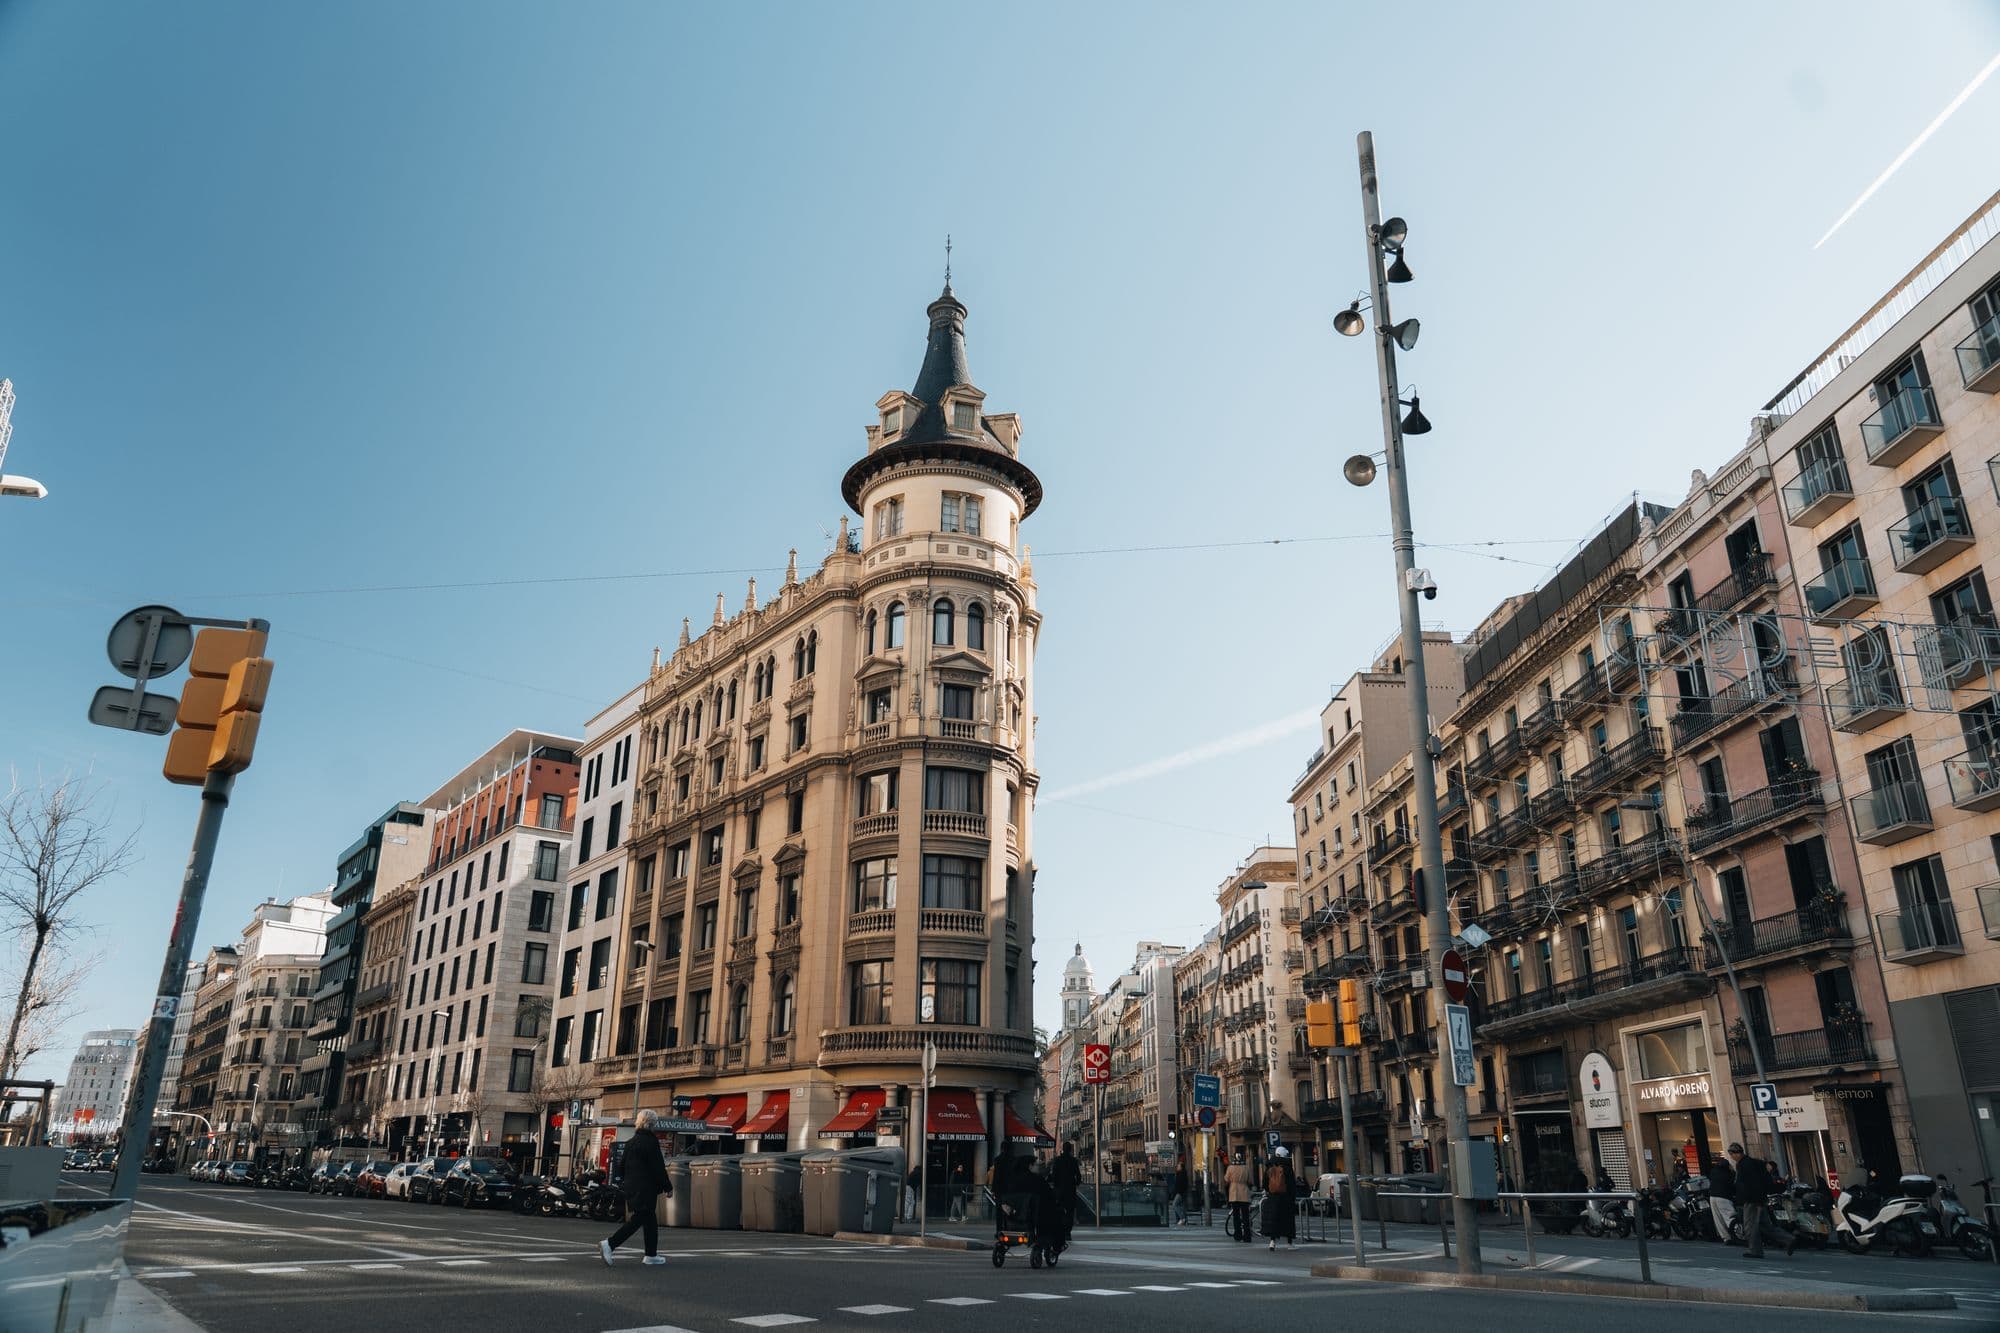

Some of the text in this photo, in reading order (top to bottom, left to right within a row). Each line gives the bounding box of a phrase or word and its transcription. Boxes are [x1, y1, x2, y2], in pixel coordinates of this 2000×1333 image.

[1262, 908, 1279, 1070] HOTEL MIDMOST
[1093, 1052, 1103, 1063] M
[1640, 1081, 1710, 1100] ALVARO MORENO
[1834, 1088, 1874, 1099] lemon
[1589, 1097, 1611, 1109] stucom
[1755, 1087, 1772, 1109] P
[571, 1102, 579, 1118] P
[654, 1119, 704, 1130] AVANGUARDIA
[1012, 1135, 1036, 1144] MARNI
[1269, 1132, 1279, 1145] P
